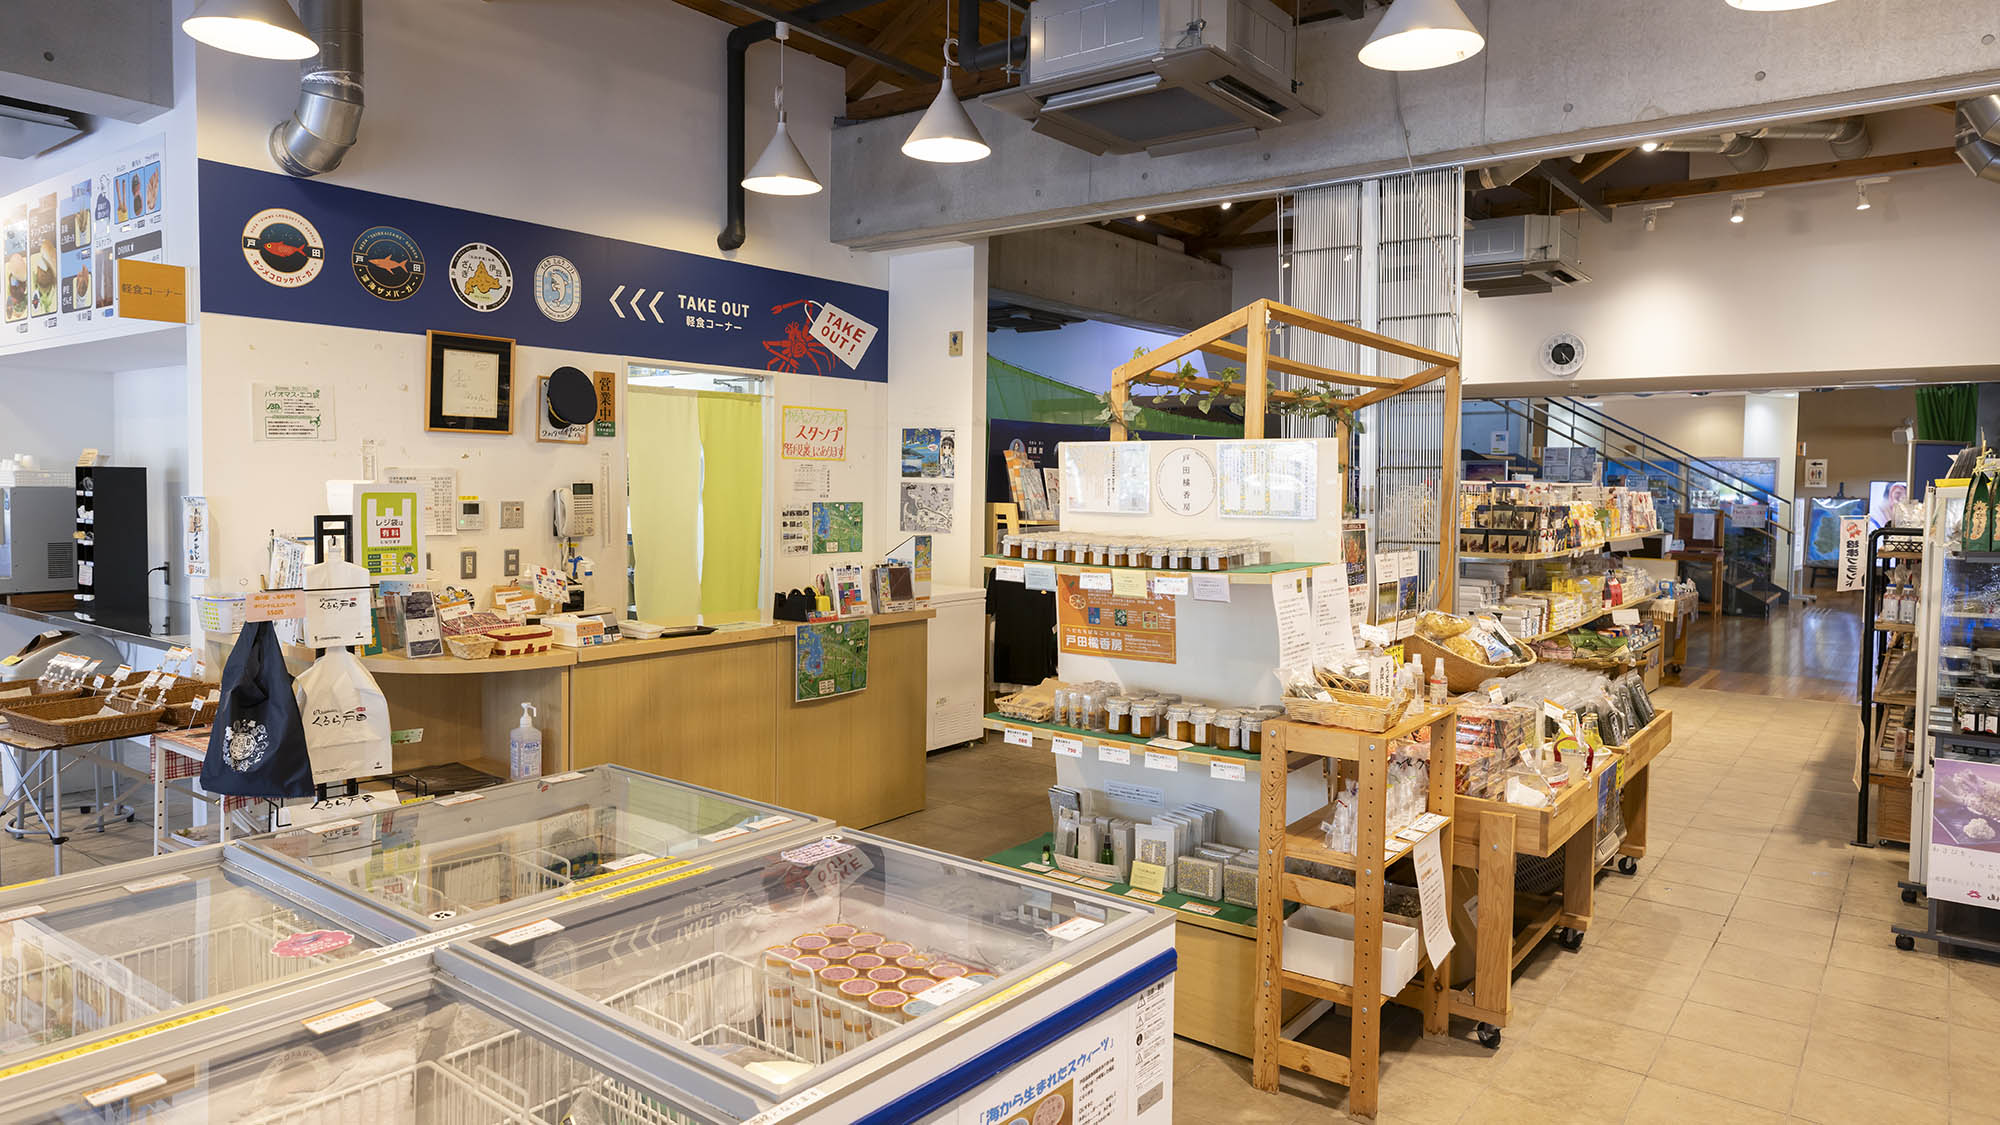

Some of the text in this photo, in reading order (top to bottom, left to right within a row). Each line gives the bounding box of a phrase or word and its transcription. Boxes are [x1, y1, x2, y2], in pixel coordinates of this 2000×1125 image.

[311, 248, 321, 257] 田
[413, 263, 421, 272] 田
[121, 283, 183, 298] 軽食コーナー
[678, 294, 750, 318] TAKE OUT
[685, 315, 743, 332] 軽食コーナー
[826, 311, 867, 344] TAKE
[820, 326, 857, 356] OUT!
[599, 376, 612, 421] 営業中
[794, 424, 844, 442] スタンプ
[375, 518, 404, 527] レジ袋は
[381, 529, 400, 537] 有料
[1065, 634, 1123, 652] 戸田橘香房
[978, 1036, 1115, 1125] 「海から生まれたスウィーツ」
